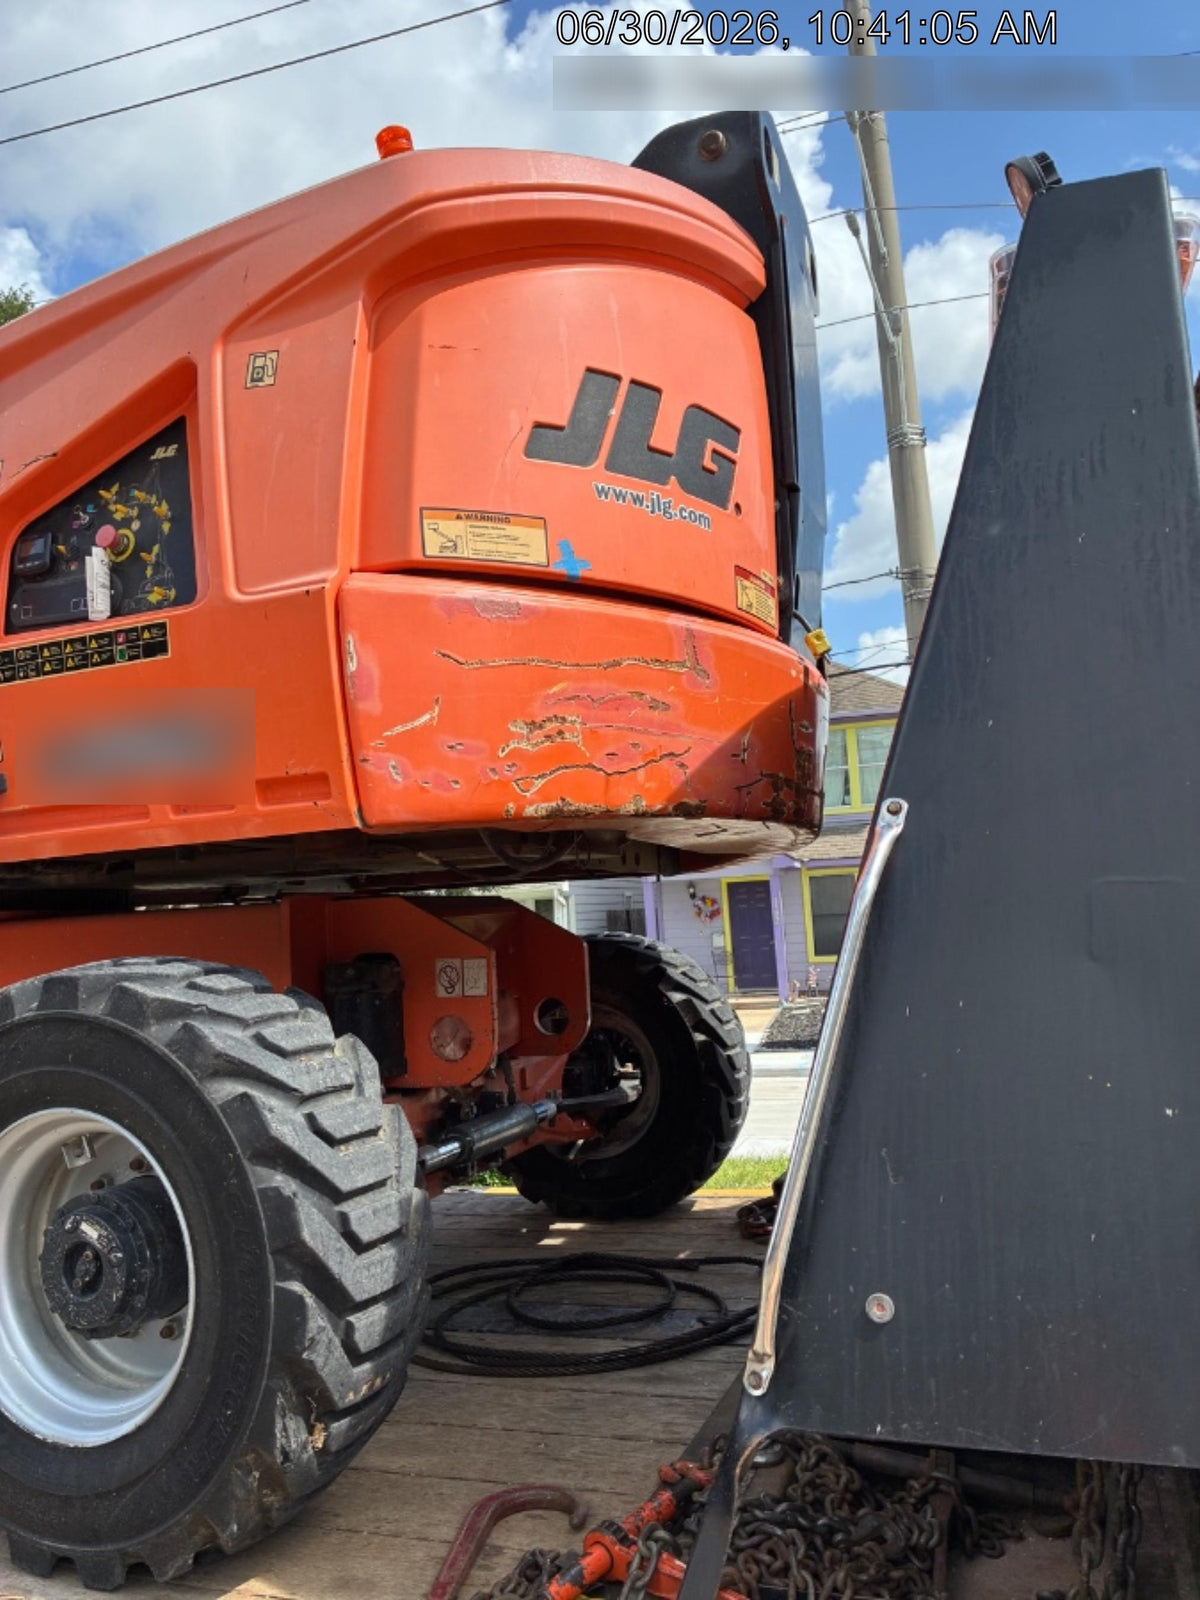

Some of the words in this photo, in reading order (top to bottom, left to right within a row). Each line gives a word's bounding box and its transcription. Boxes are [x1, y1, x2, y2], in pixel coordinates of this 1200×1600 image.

[150, 443, 178, 460] JLG
[524, 366, 741, 511] JLG
[464, 512, 512, 525] WARNING
[592, 482, 712, 532] www.jlg.com
